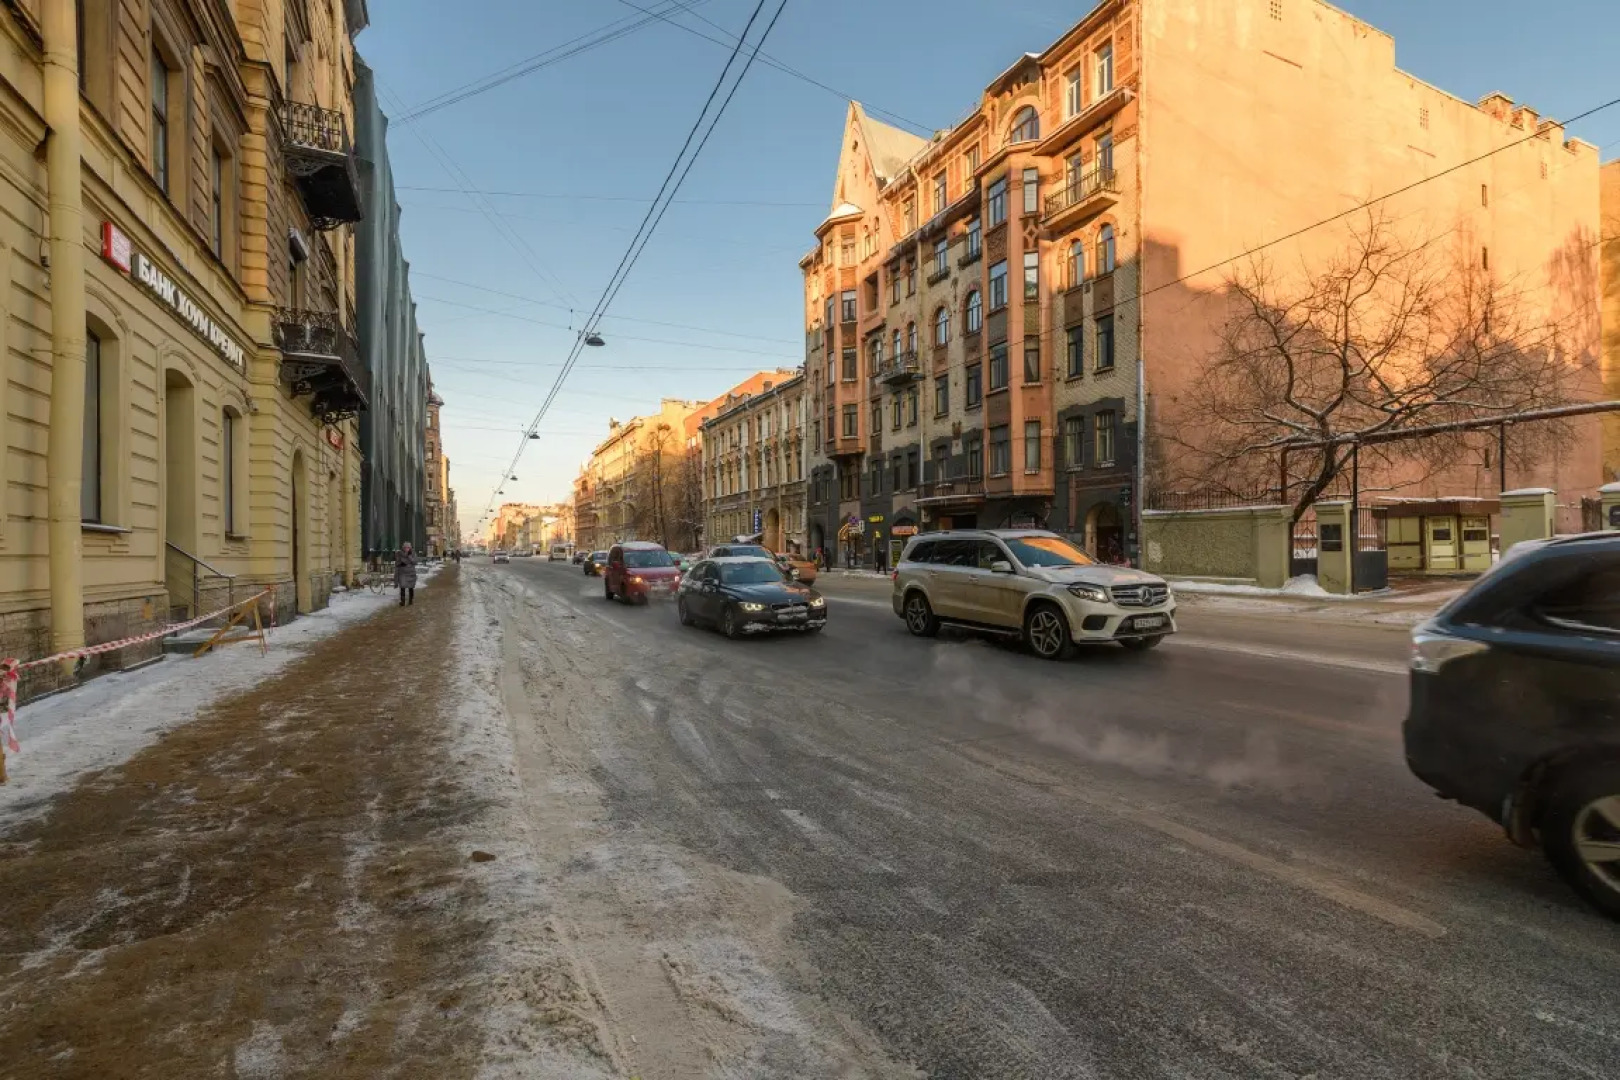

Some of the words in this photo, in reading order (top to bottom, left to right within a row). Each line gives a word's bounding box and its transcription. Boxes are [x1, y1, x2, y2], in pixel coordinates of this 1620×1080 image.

[138, 253, 176, 308] БАНК
[177, 291, 209, 337] ХОУМ
[210, 321, 244, 367] КРЕДИТ
